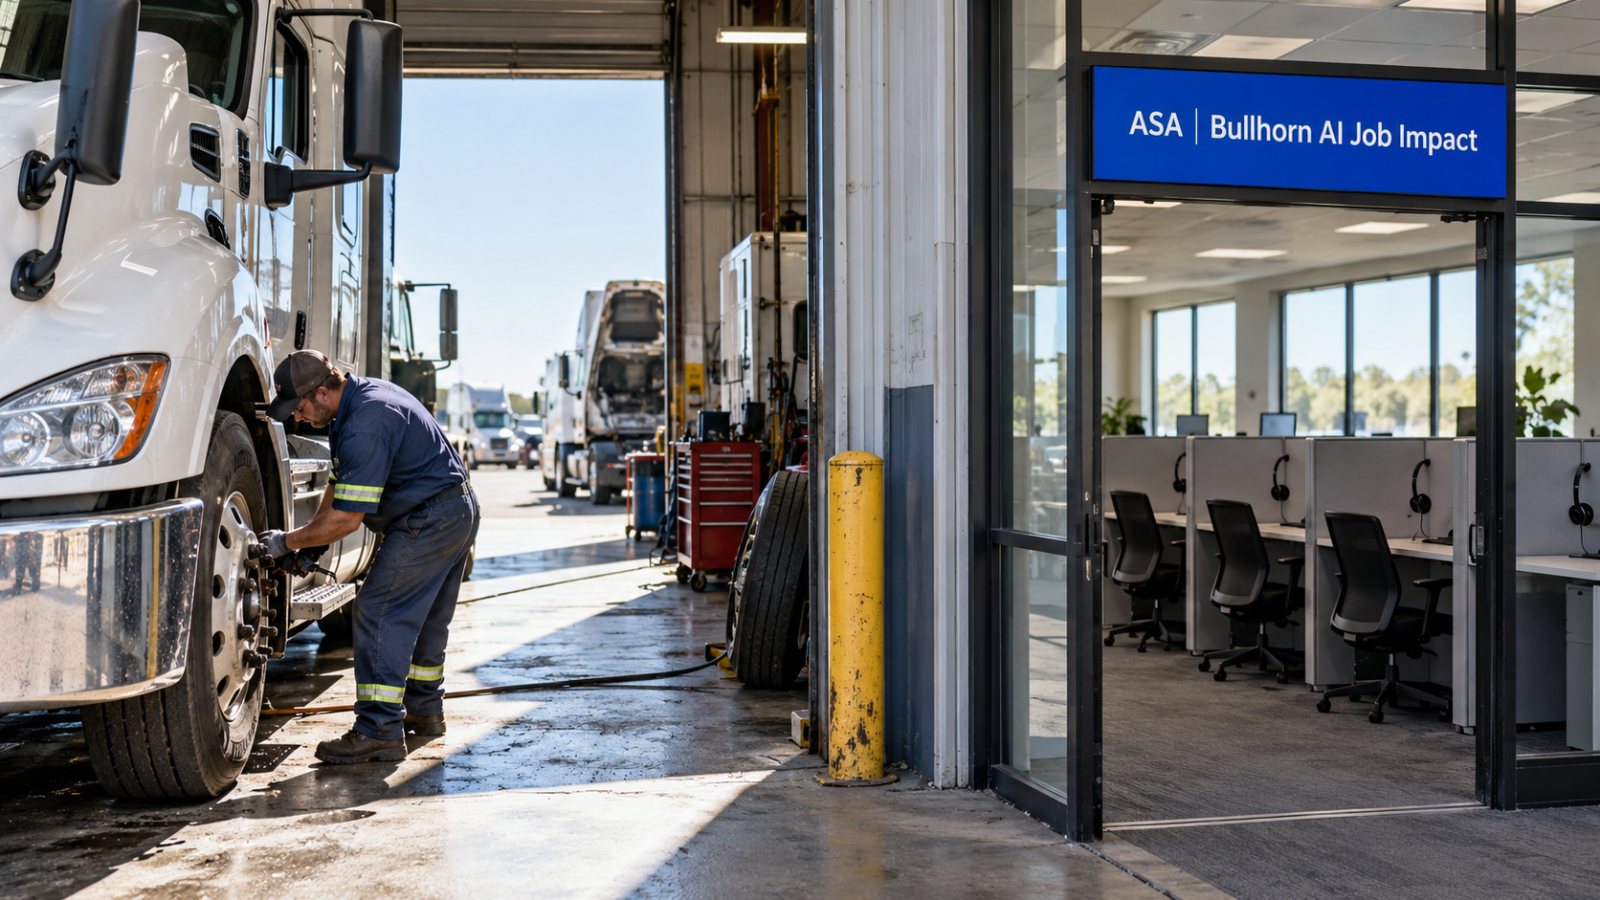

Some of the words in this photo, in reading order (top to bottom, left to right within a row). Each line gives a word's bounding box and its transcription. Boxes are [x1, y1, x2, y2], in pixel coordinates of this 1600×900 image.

[1129, 110, 1184, 137] ASA
[1211, 114, 1312, 144] Bullhorn
[1318, 120, 1343, 145] AI
[1349, 121, 1392, 148] Job
[1399, 124, 1478, 156] Impact
